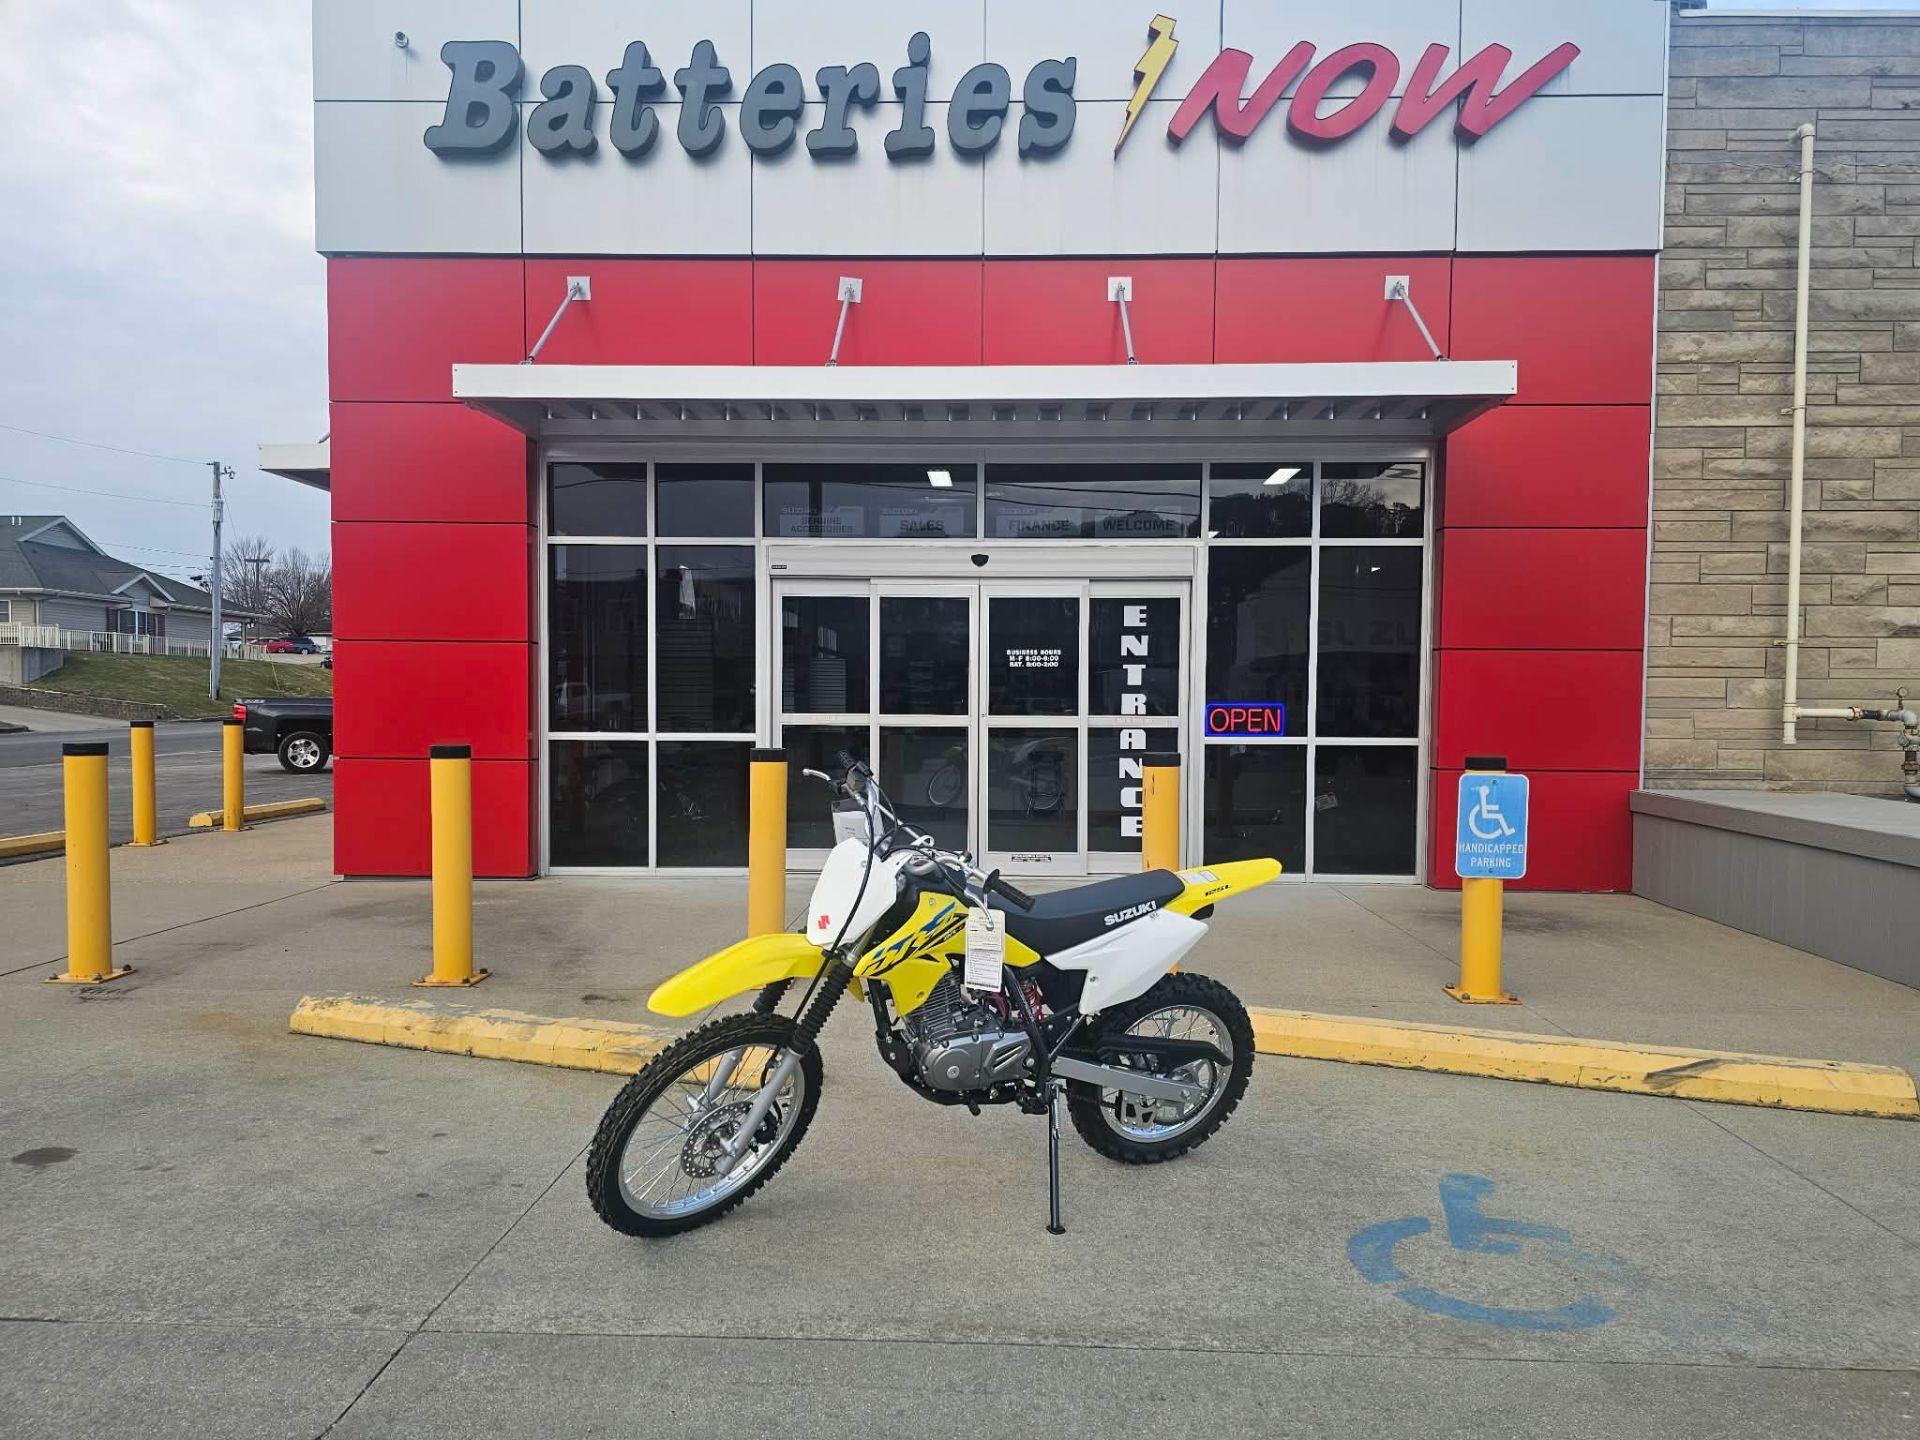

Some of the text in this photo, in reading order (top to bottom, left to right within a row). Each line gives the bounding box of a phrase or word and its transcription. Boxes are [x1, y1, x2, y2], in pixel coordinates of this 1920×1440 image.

[423, 32, 1581, 161] Batteries NOW
[900, 519, 945, 532] SALES
[1008, 519, 1070, 532] FINANCE
[1102, 519, 1175, 532] WELCOME
[1119, 605, 1148, 837] ENTRANCE
[1209, 707, 1282, 733] OPEN
[1459, 843, 1524, 854] HANDICAPPED
[1470, 857, 1511, 868] PARKING
[1104, 900, 1157, 926] SUZUKI
